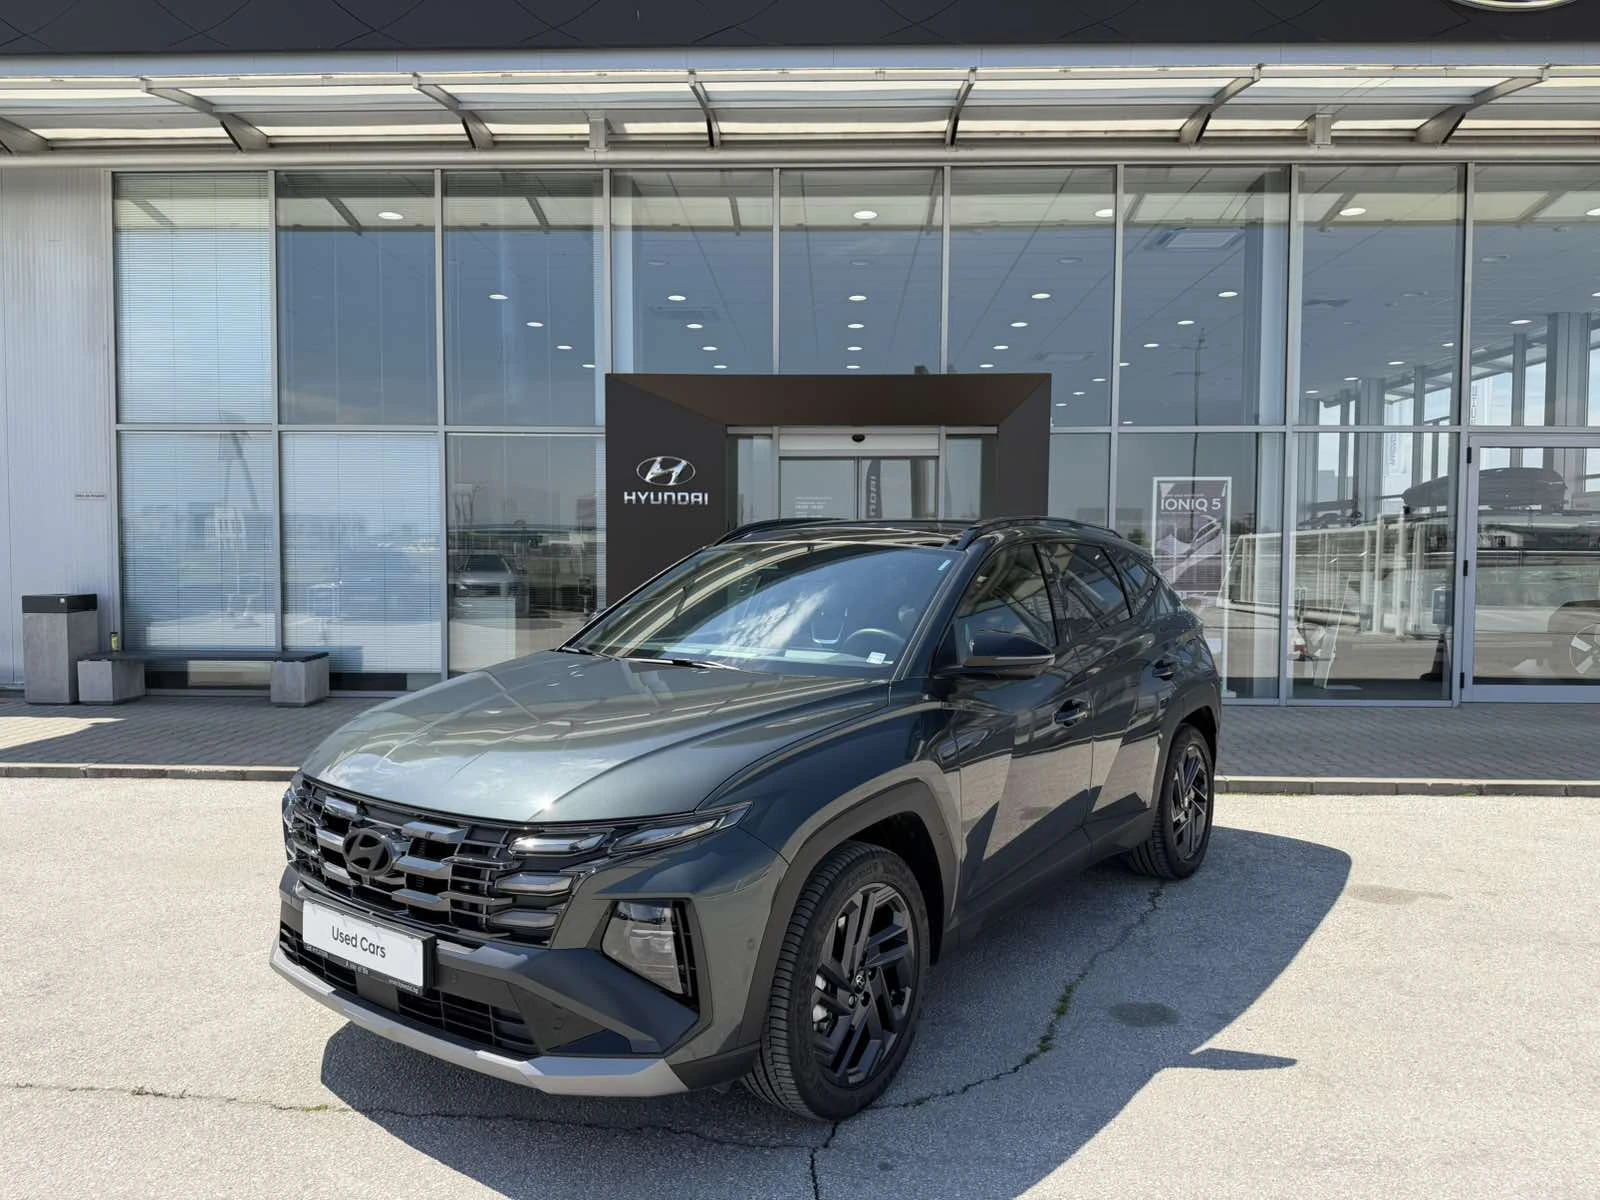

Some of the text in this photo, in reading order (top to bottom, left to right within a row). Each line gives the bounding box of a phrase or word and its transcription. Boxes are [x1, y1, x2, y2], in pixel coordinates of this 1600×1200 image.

[623, 491, 709, 505] HYUNDAI
[1161, 498, 1222, 512] IONIQ 5
[331, 926, 386, 958] Used Cars
